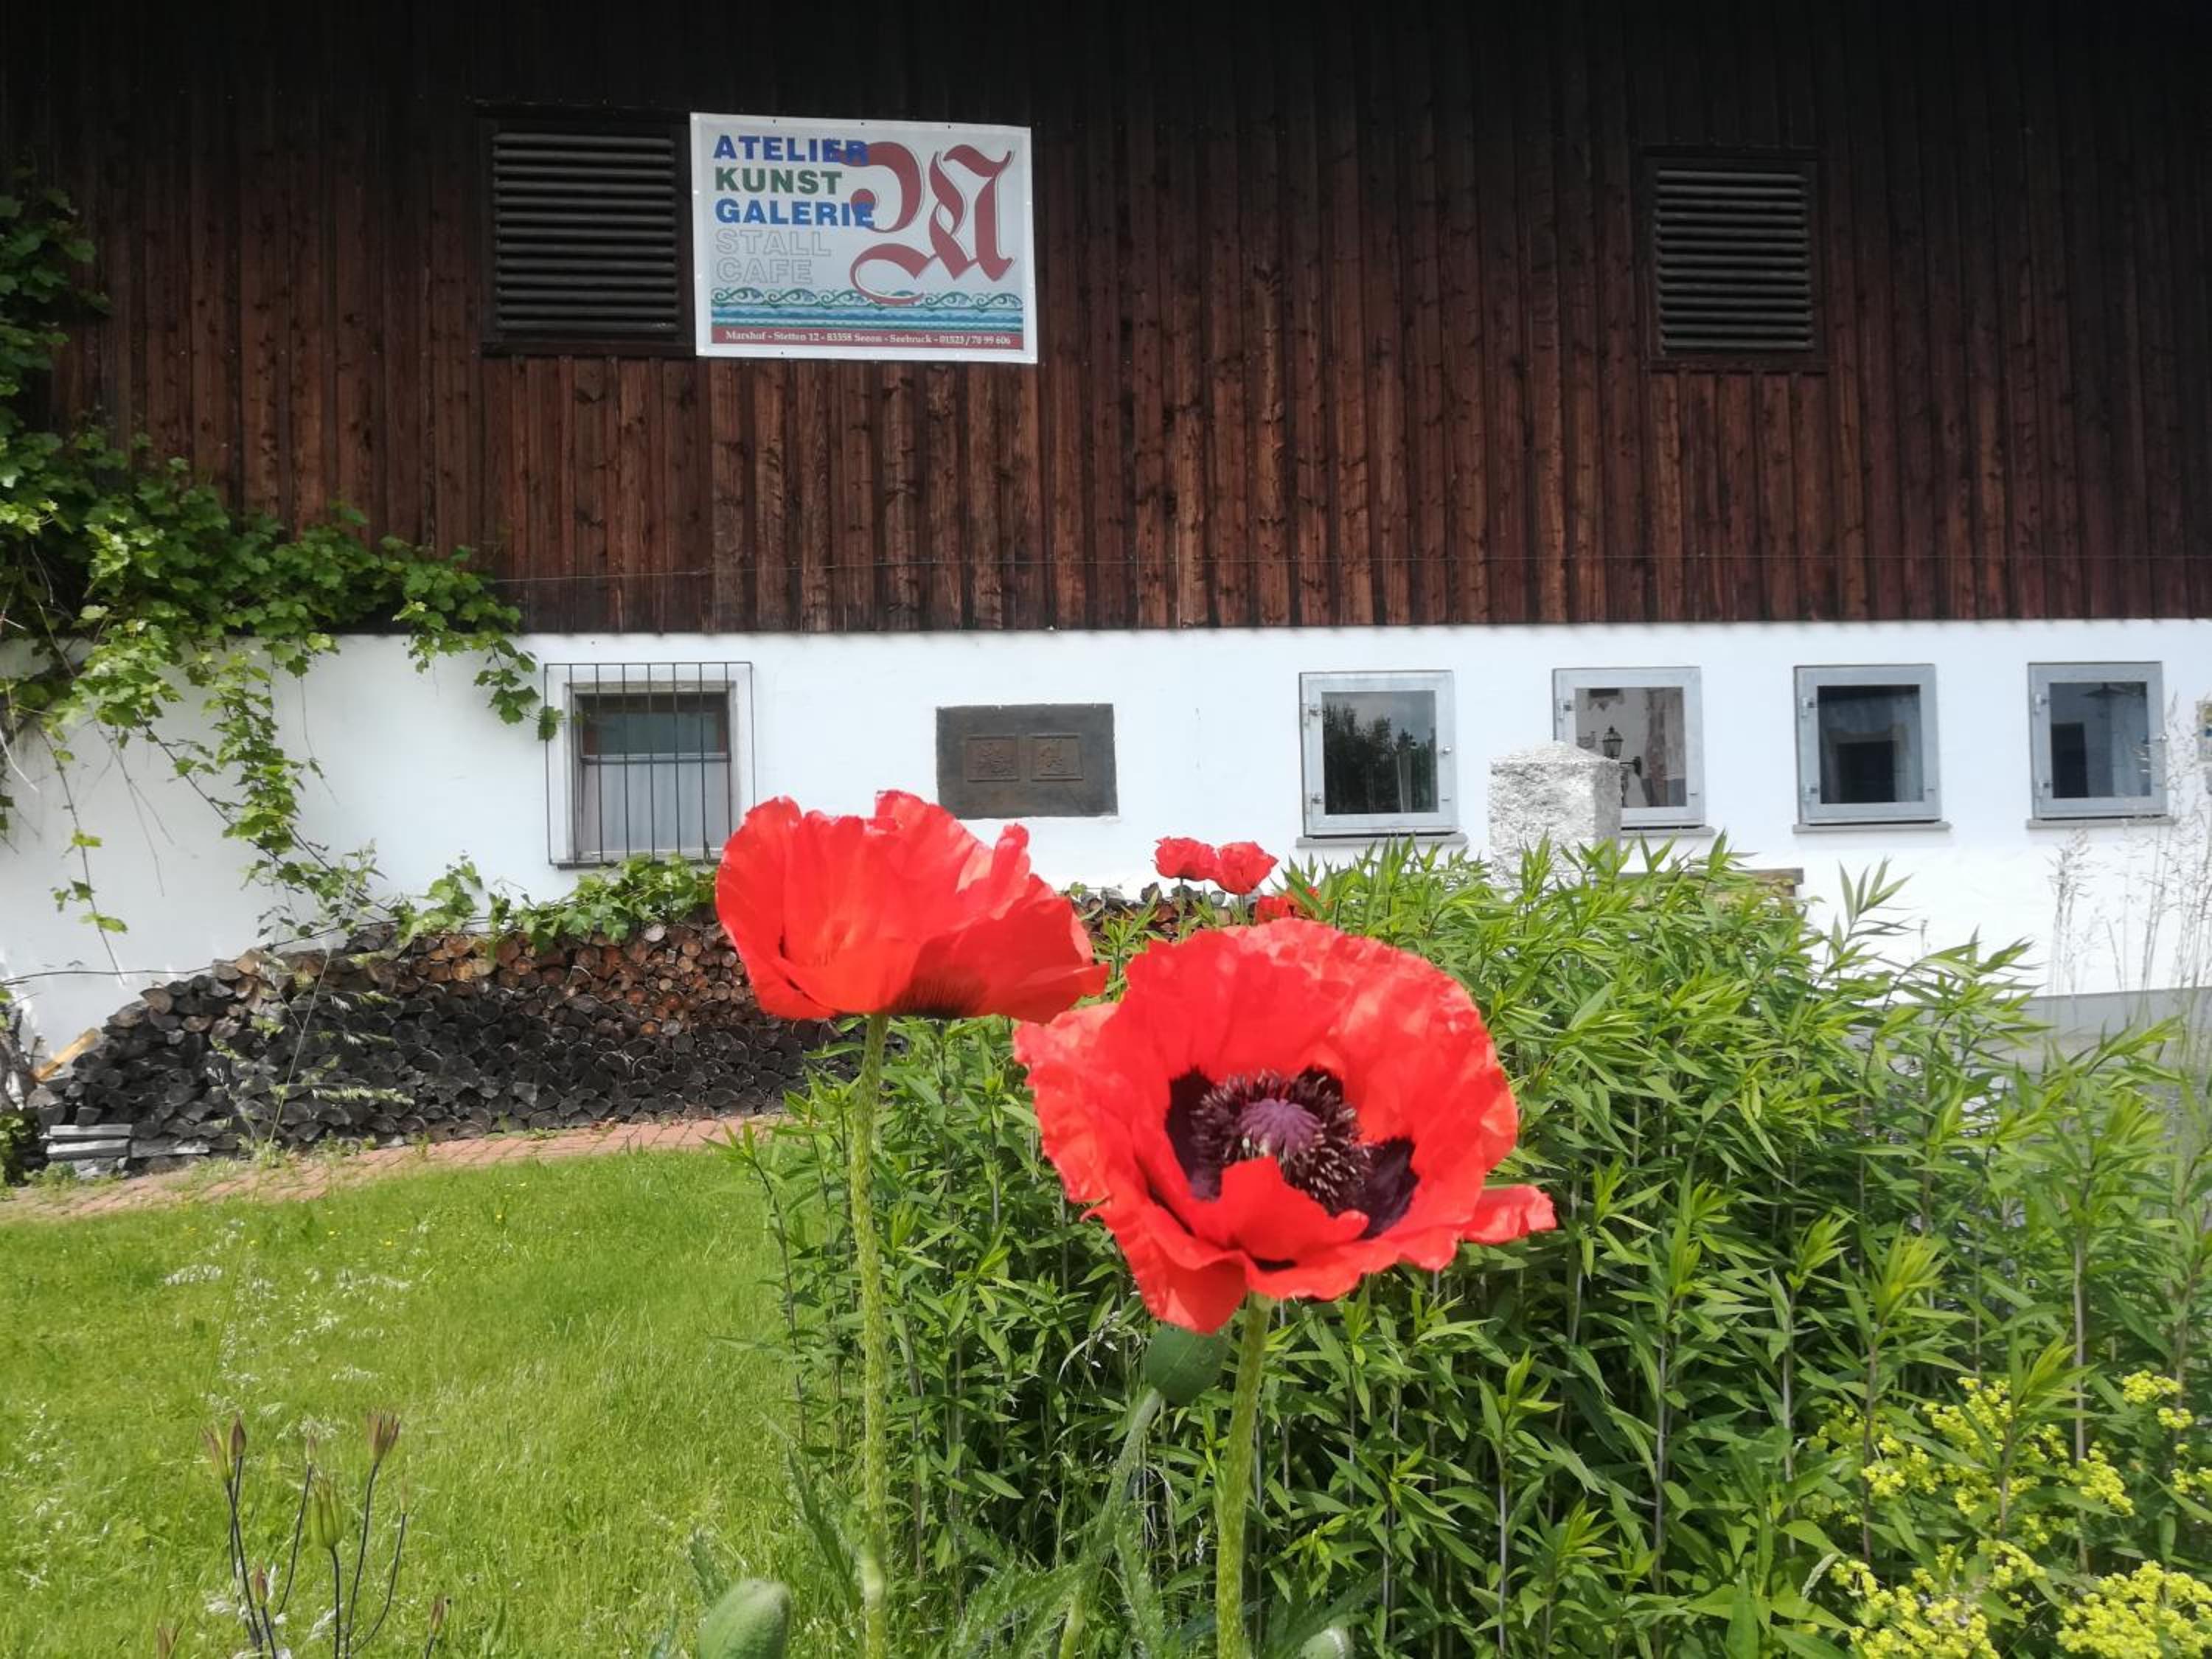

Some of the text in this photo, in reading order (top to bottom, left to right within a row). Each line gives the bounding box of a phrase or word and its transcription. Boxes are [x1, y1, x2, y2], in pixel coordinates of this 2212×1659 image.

[713, 135, 869, 164] ATELIER
[714, 166, 842, 195] KUNST
[714, 198, 874, 227] GALERIE
[715, 229, 831, 257] STALL
[716, 258, 813, 285] CAFE
[809, 332, 819, 341] 12
